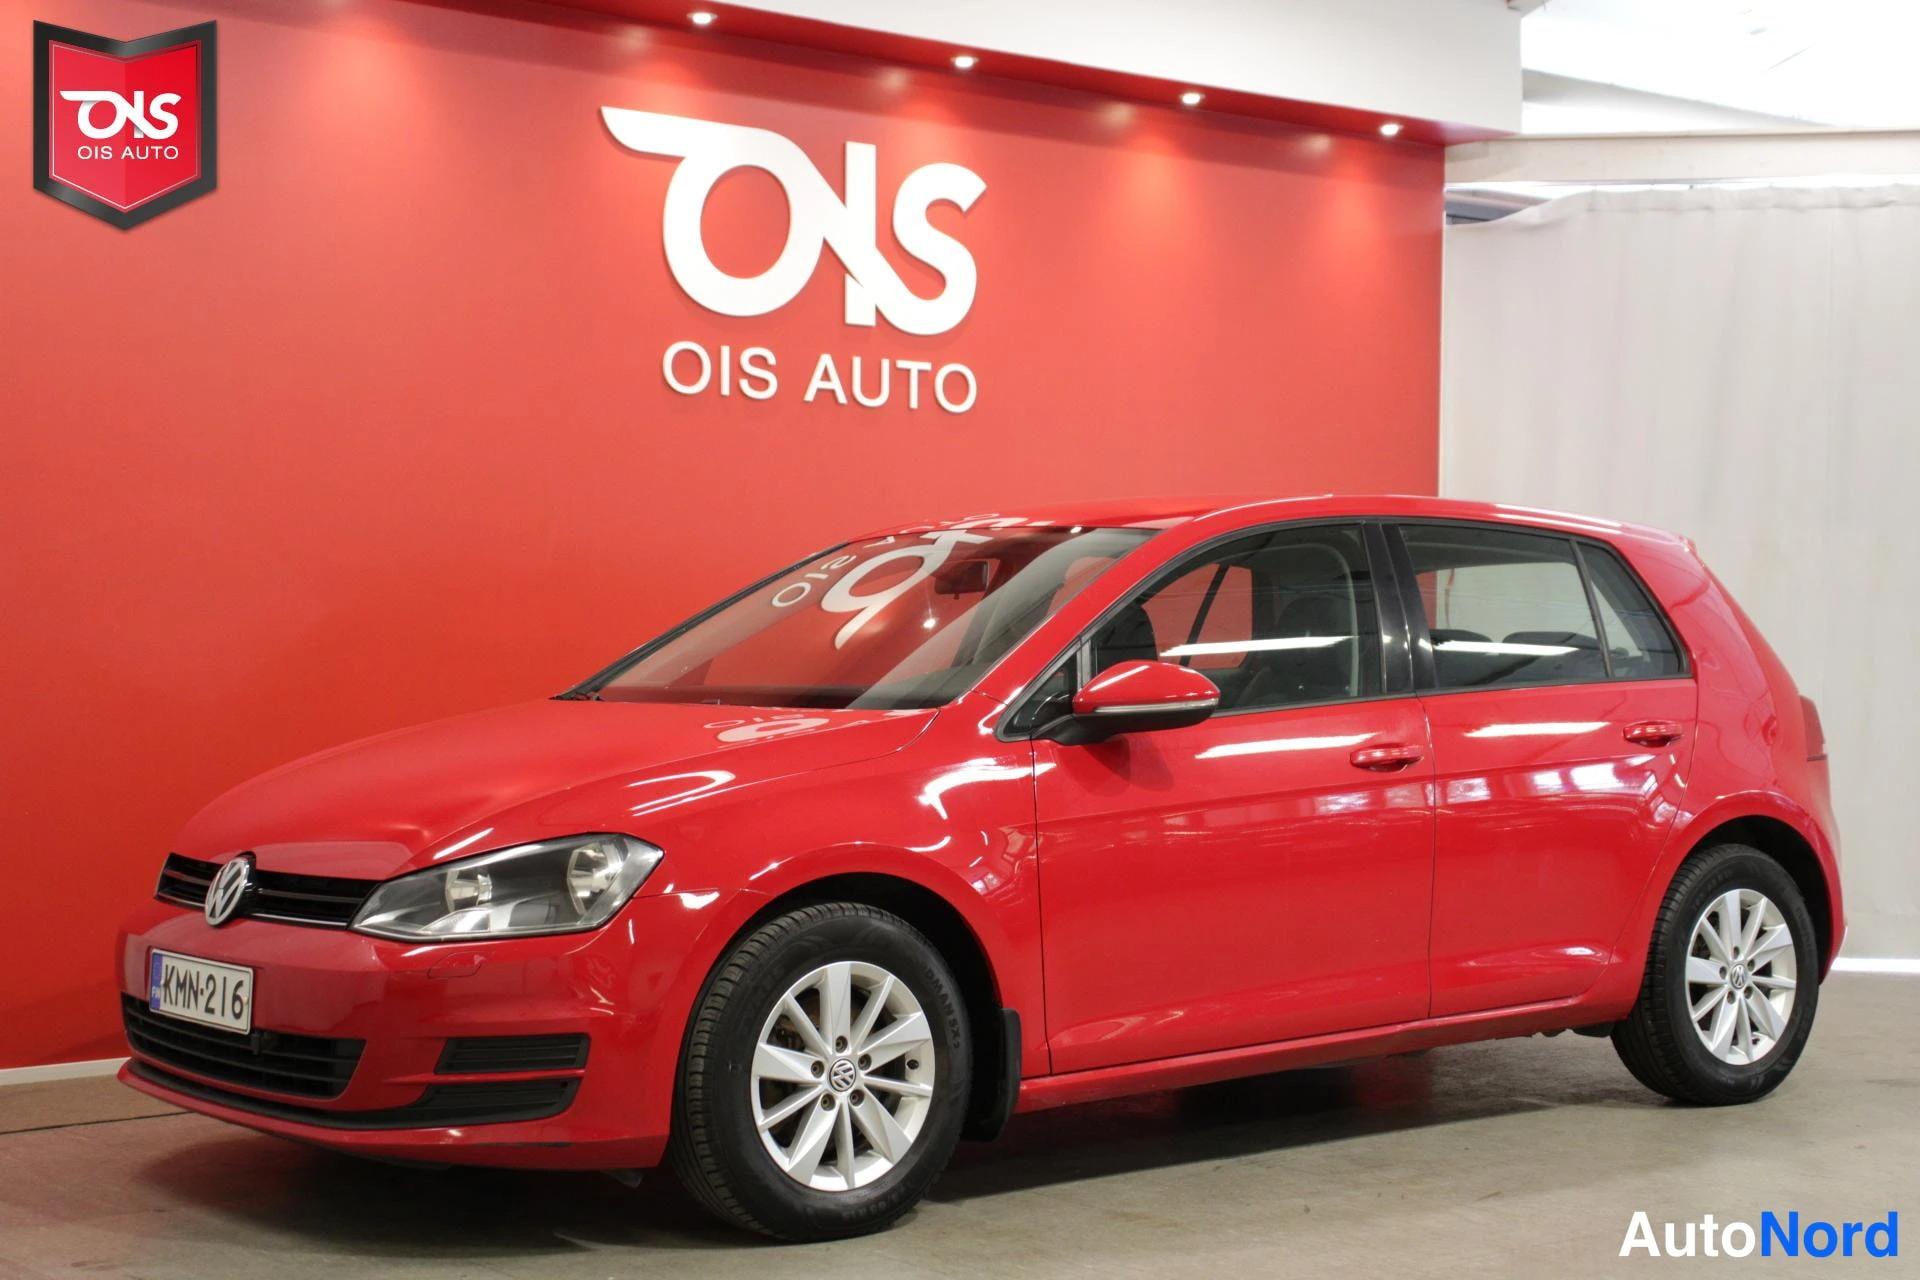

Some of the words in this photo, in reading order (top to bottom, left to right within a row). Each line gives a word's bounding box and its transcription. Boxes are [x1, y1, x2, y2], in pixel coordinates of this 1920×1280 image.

[662, 340, 779, 400] OIS
[803, 353, 978, 414] AUTO
[162, 963, 245, 1021] KMN-216
